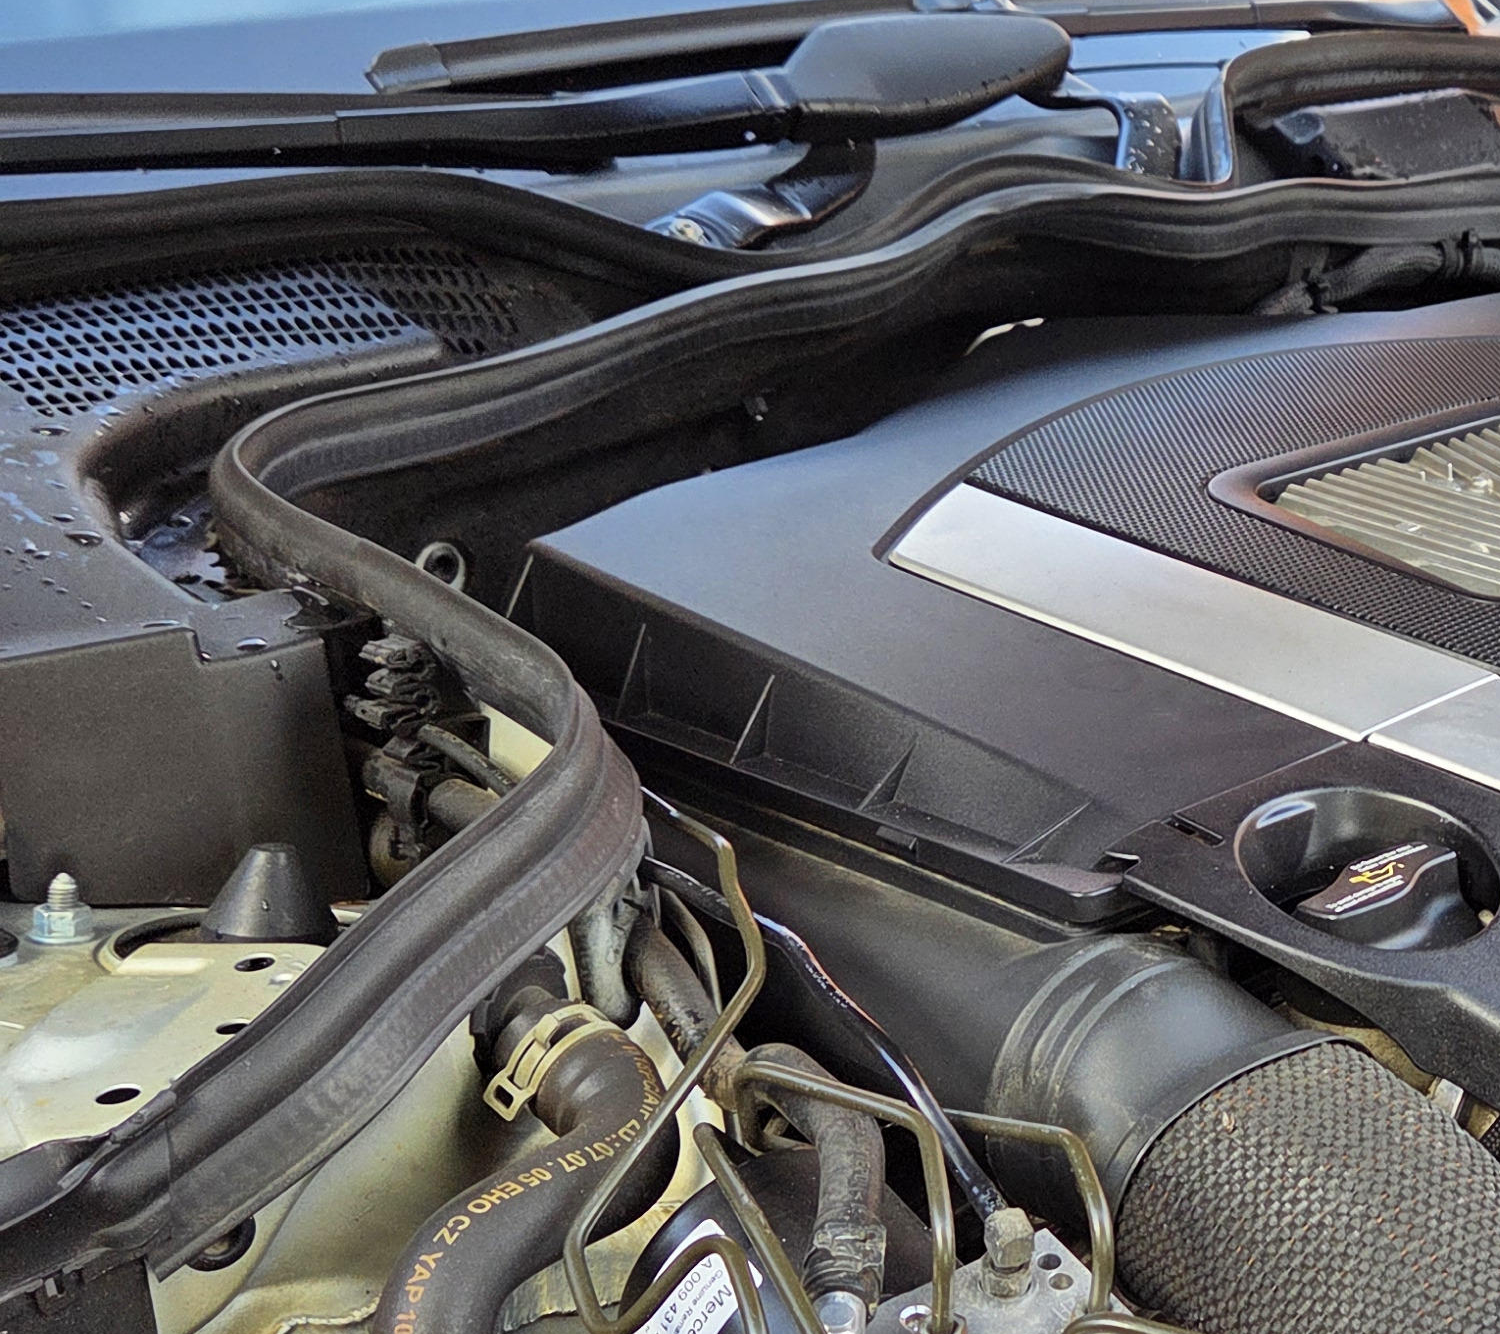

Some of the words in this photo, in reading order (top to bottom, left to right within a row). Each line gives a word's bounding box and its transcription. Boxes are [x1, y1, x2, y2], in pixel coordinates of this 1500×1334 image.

[432, 1214, 471, 1245] CZ
[404, 1251, 444, 1304] YAP
[700, 1257, 713, 1270] A
[677, 1270, 702, 1302] 009
[692, 1269, 724, 1307] Genuine
[659, 1301, 678, 1332] 431
